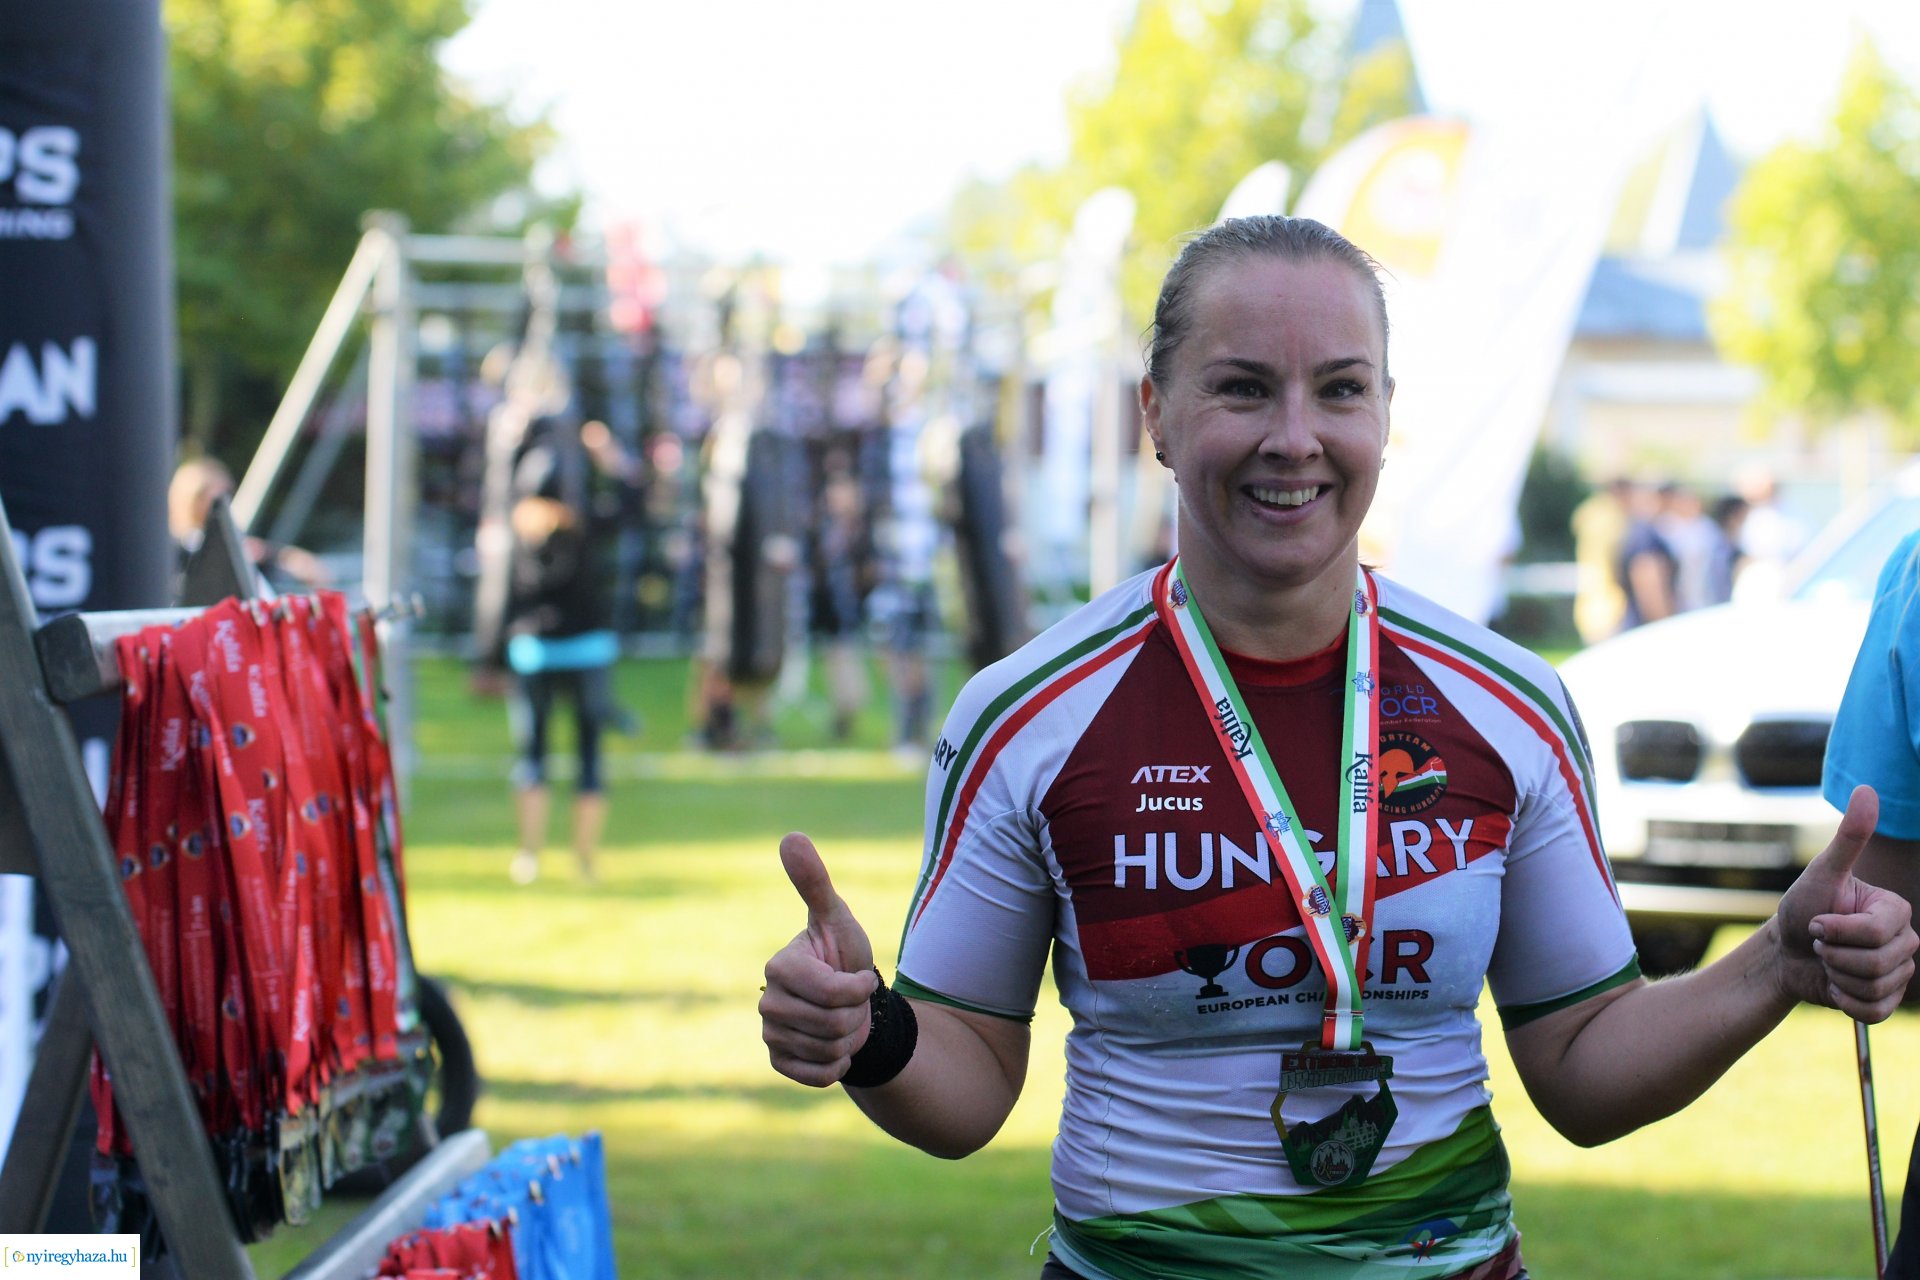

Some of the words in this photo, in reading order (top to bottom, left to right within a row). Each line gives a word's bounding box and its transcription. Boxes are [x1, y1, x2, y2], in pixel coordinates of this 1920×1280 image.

[1380, 684, 1425, 697] ORLD
[1214, 696, 1253, 762] Kalifa
[1131, 765, 1212, 784] ATEX
[1345, 752, 1375, 814] Kalifa
[1135, 793, 1204, 813] Jucus
[1379, 802, 1407, 814] ACING
[1245, 929, 1435, 989] OR
[1197, 993, 1289, 1014] EUROPEAN
[1295, 989, 1430, 1004] CHONSHIPS
